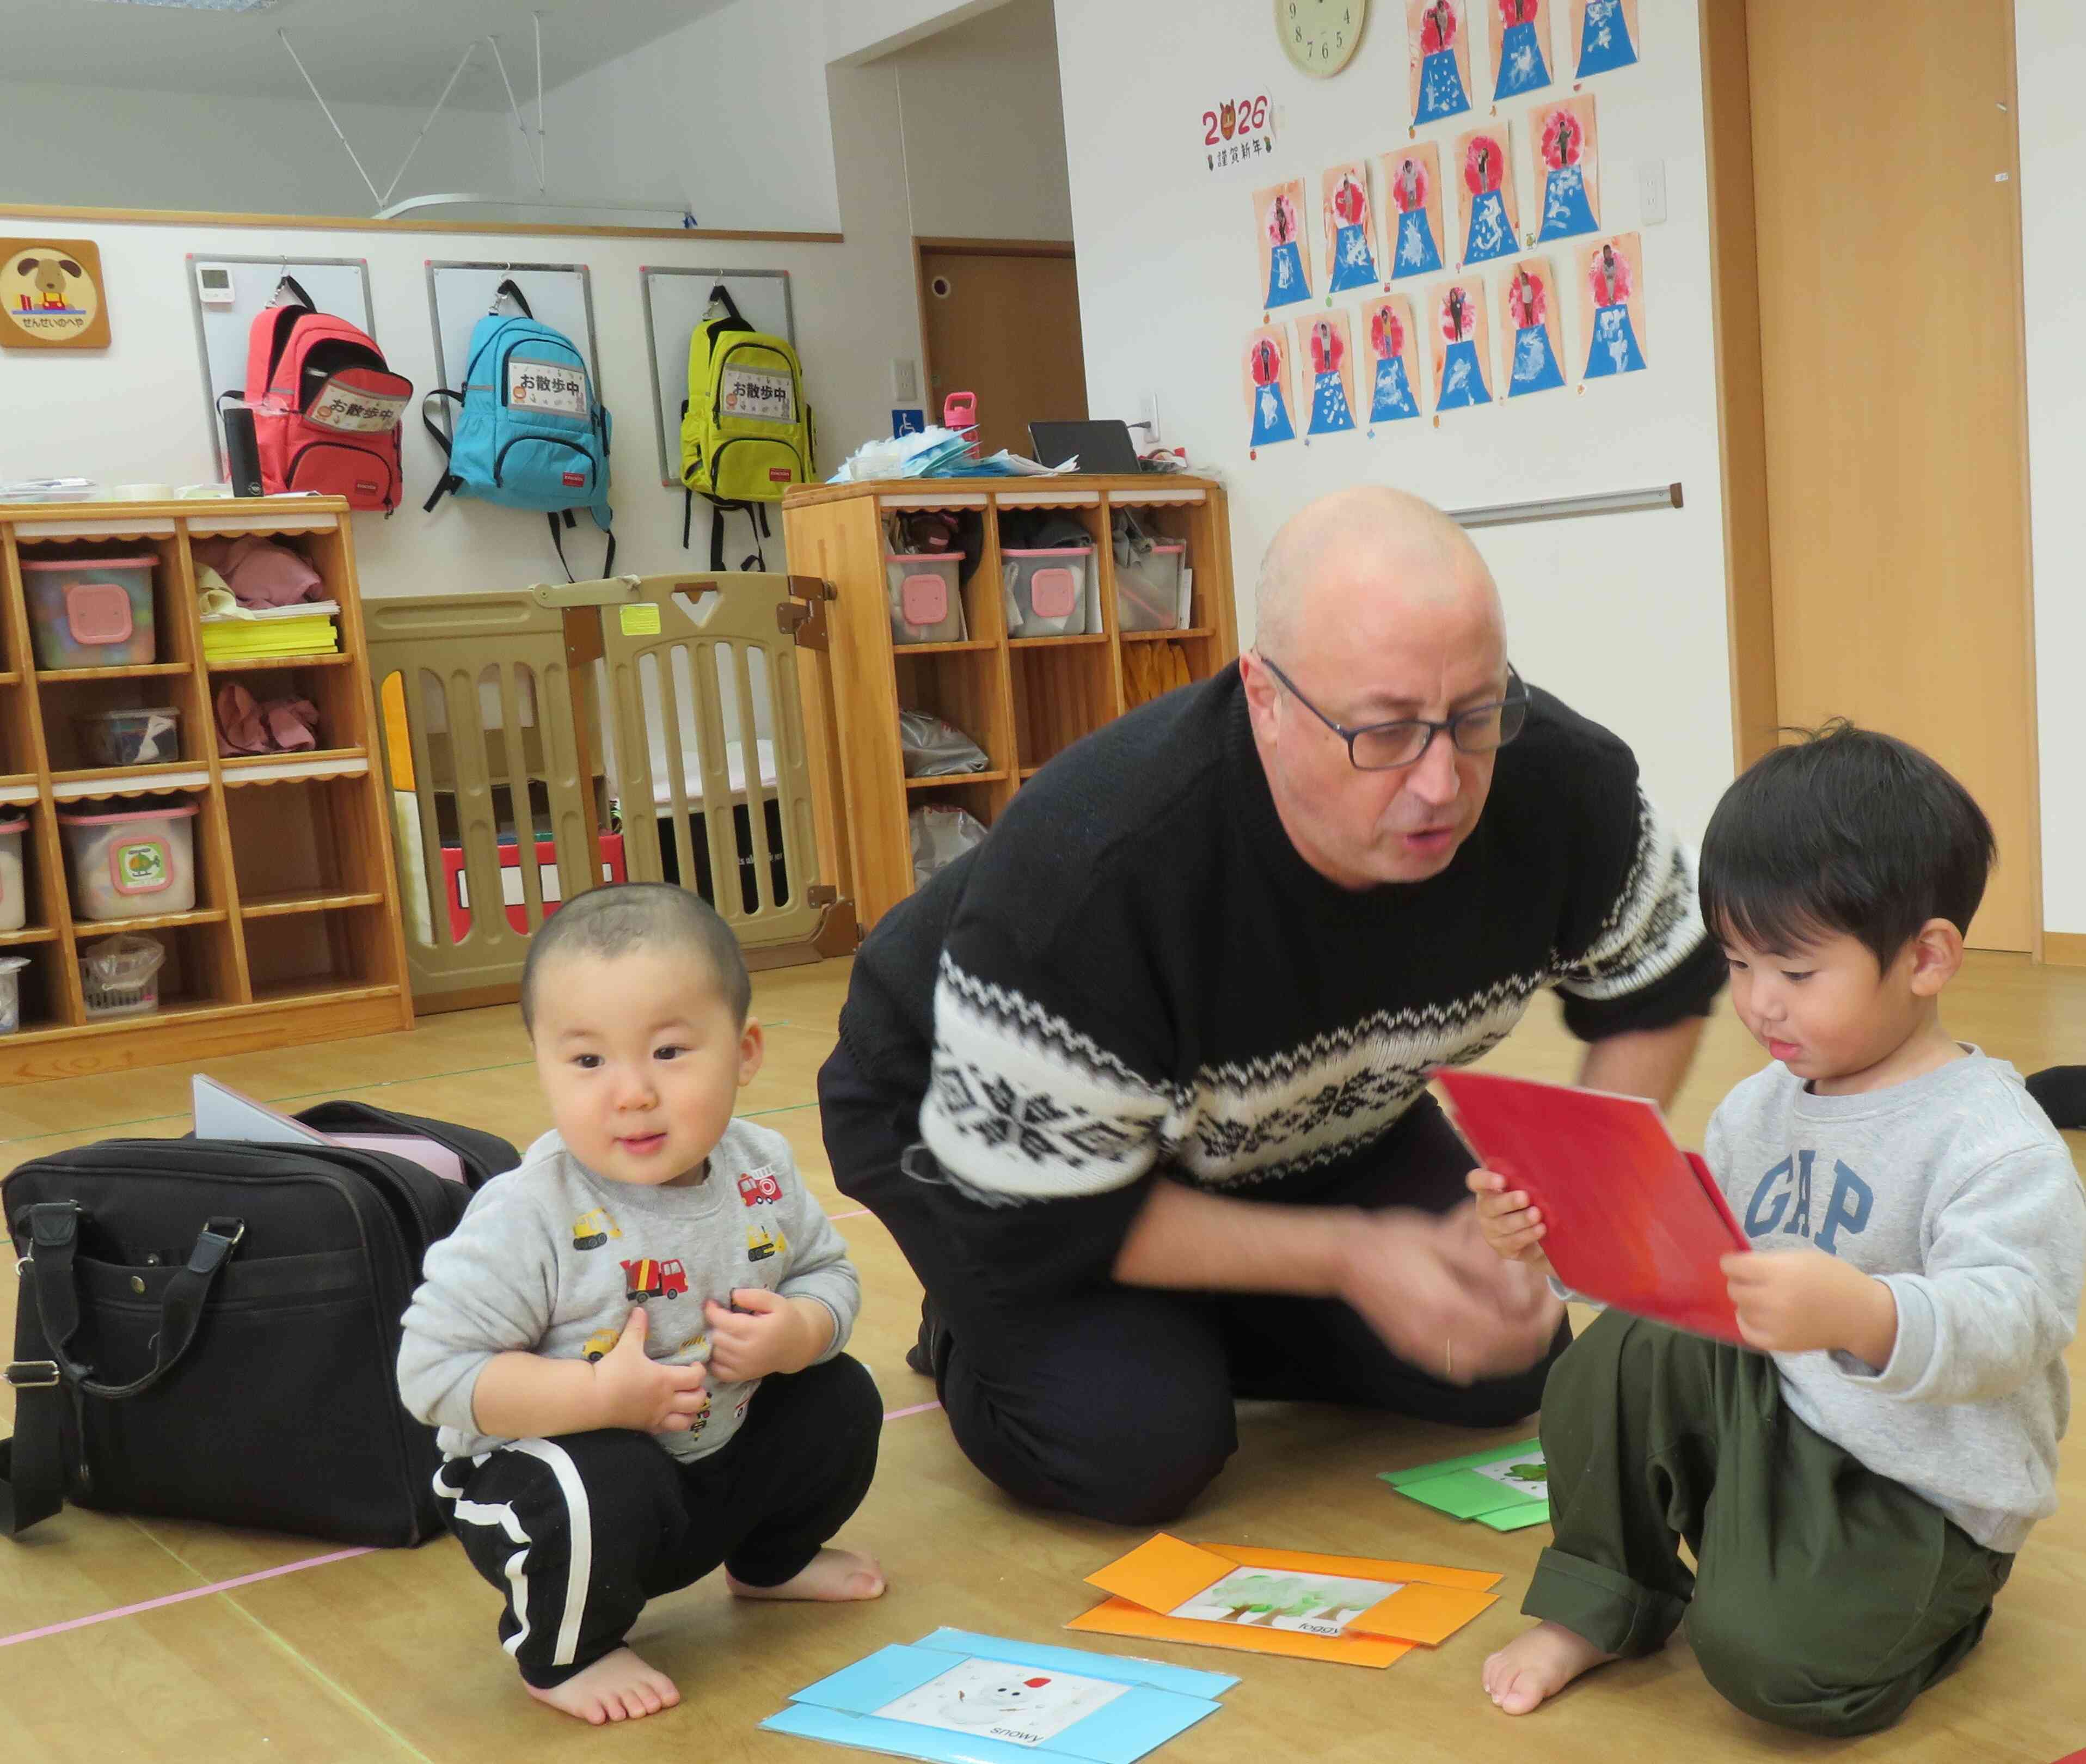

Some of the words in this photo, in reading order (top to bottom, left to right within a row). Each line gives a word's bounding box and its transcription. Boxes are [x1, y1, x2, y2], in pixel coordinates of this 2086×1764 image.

[1290, 3, 1296, 19] 9
[1343, 7, 1350, 24] 4
[1295, 26, 1302, 42] 8
[1336, 31, 1342, 48] 5
[1307, 41, 1313, 60] 7
[1322, 42, 1329, 60] 6
[1217, 139, 1262, 167] 謹賀新年
[23, 318, 84, 328] せんせいのへや
[520, 373, 579, 396] お散歩中
[733, 382, 786, 402] お散歩中
[330, 399, 393, 420] お散歩中
[1744, 1149, 1874, 1255] GAP
[990, 1727, 1044, 1743] snowy
